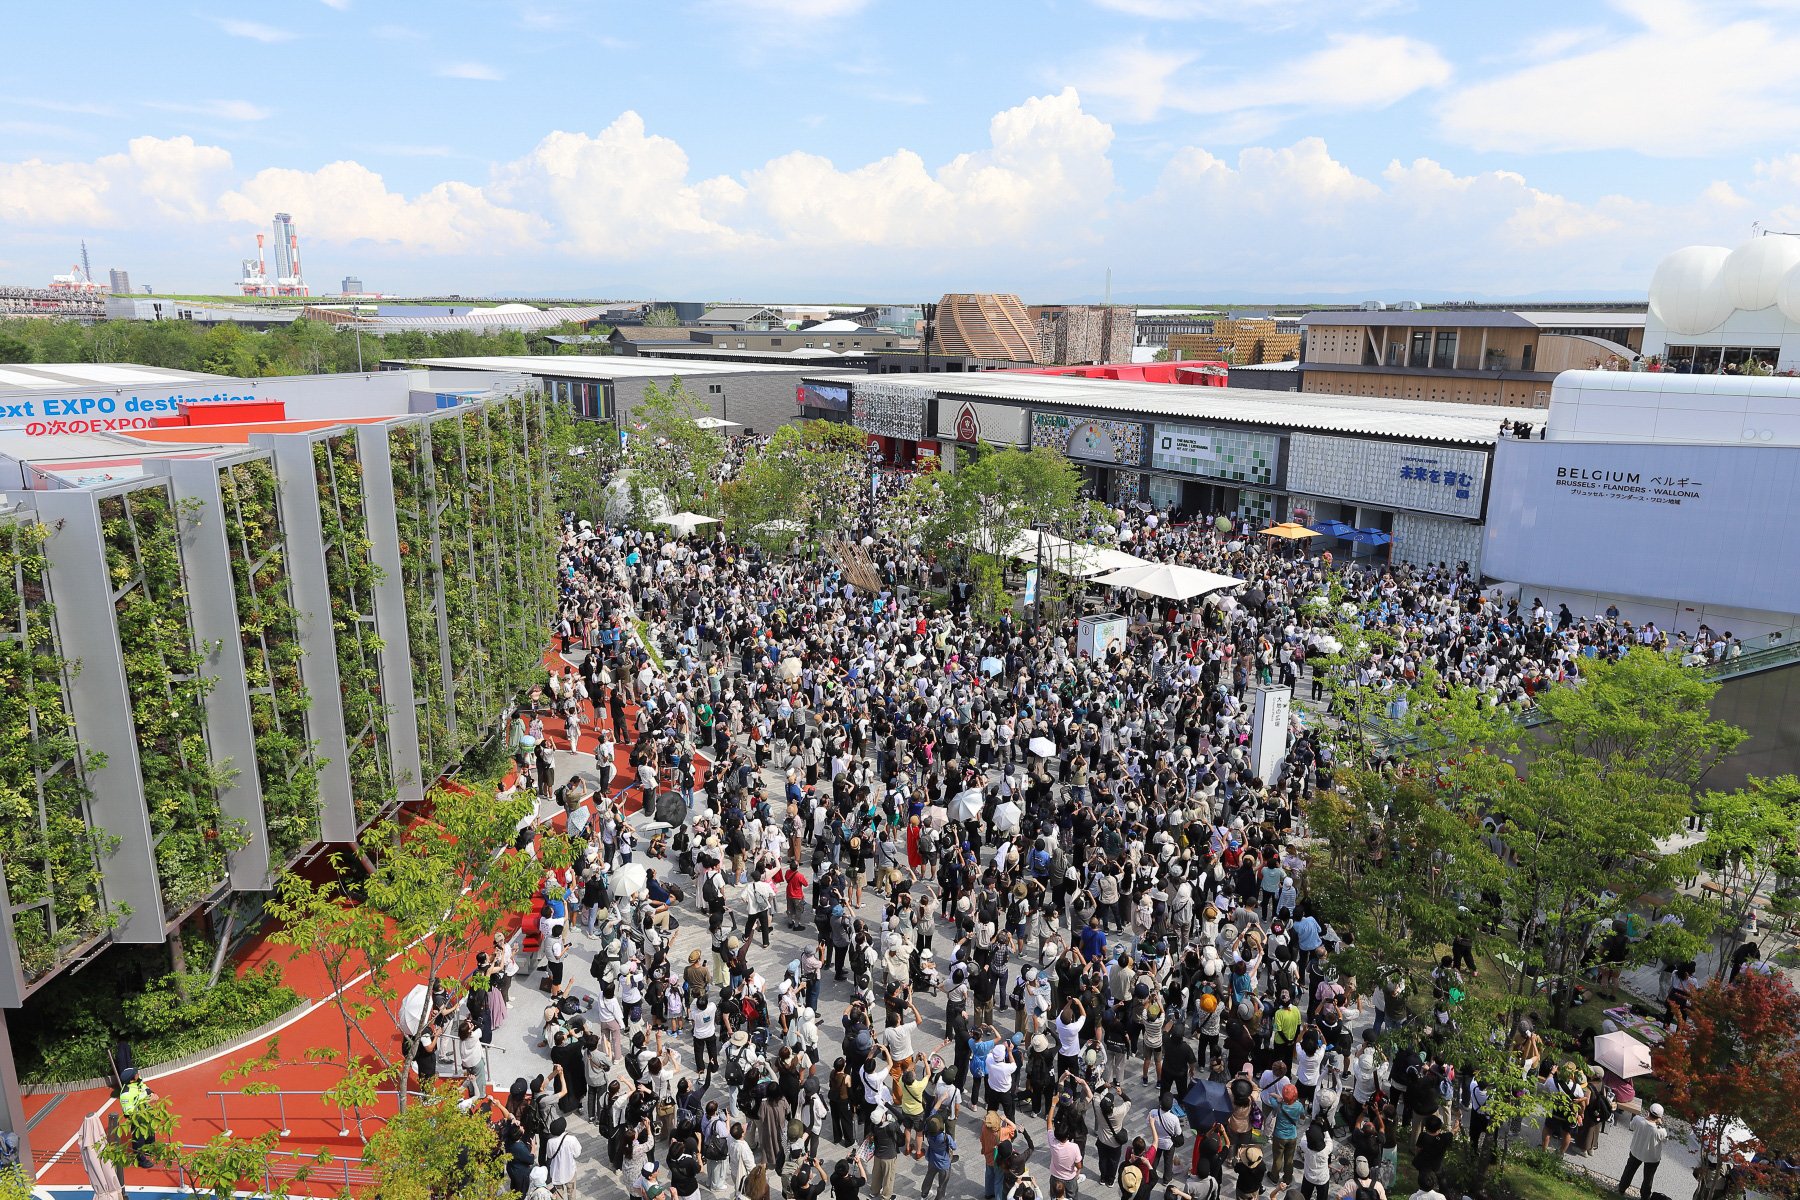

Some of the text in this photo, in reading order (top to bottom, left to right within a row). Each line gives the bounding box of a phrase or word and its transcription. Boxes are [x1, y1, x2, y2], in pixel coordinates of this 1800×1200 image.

[43, 397, 116, 416] EXPO
[125, 393, 256, 412] destiti
[1400, 465, 1473, 487] 未来を育む
[1557, 467, 1640, 484] BELGIUM
[1650, 476, 1702, 488] ベルギー
[1556, 480, 1700, 498] BRUSSELS FLANDERS WALLONIA
